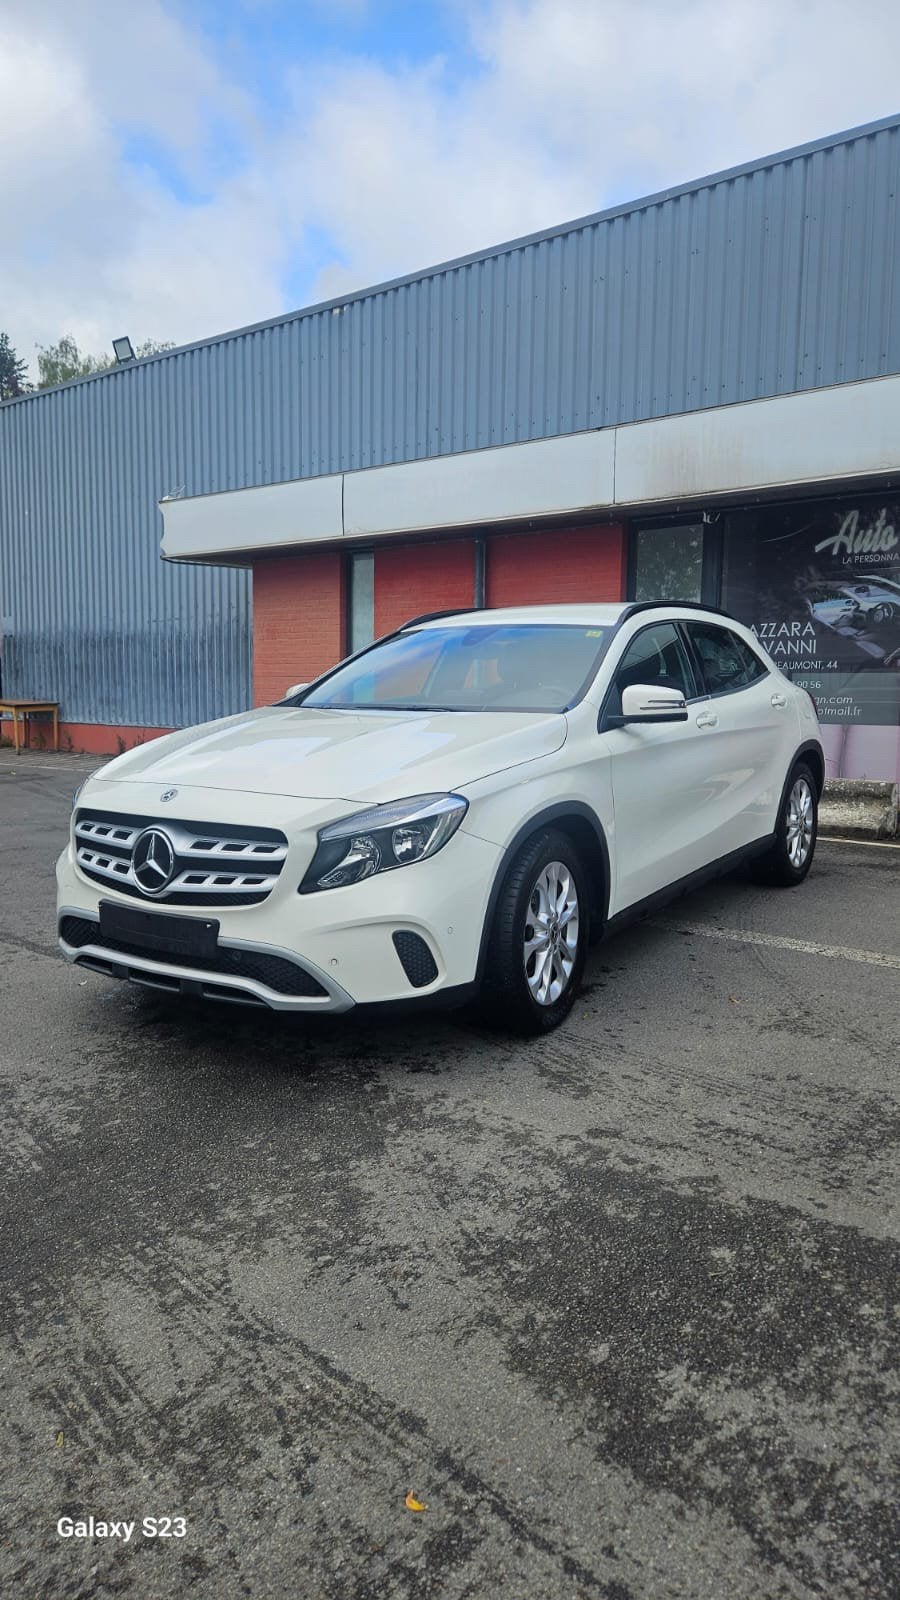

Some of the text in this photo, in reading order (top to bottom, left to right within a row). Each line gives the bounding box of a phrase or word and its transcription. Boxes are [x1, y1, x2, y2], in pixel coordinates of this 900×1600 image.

[815, 507, 898, 555] Auto
[842, 556, 852, 564] LA
[826, 660, 838, 669] 44
[810, 680, 822, 689] 56
